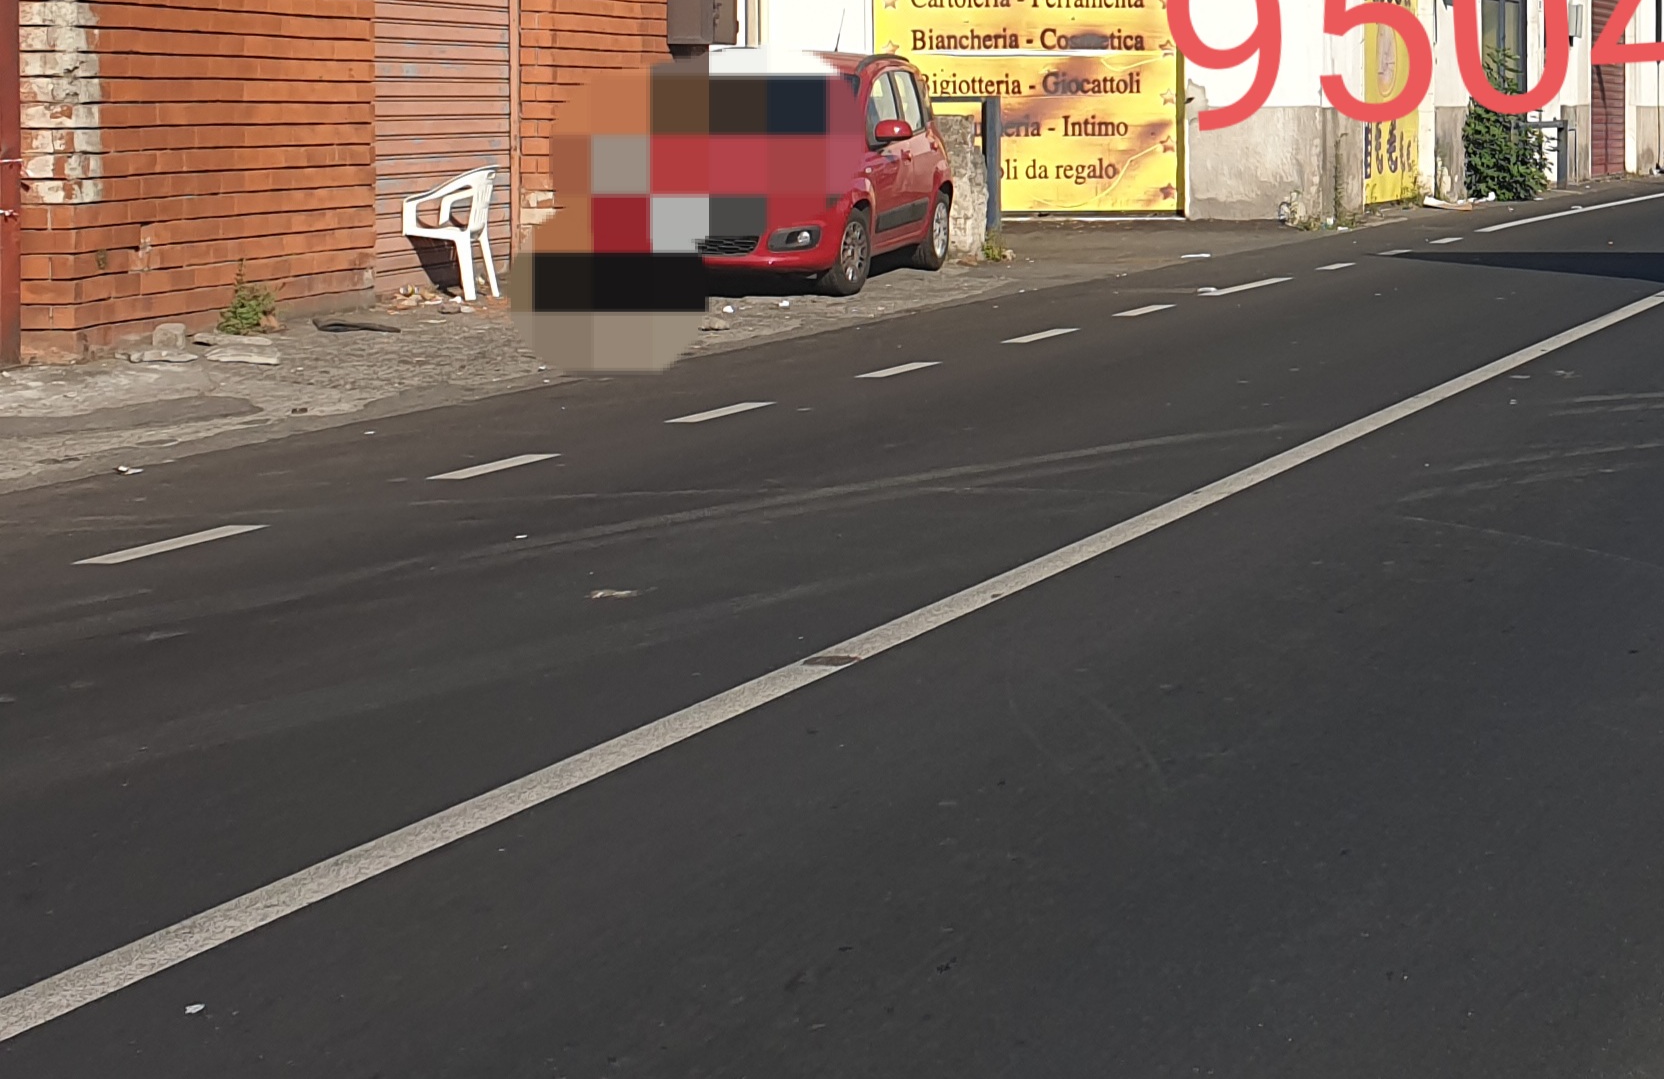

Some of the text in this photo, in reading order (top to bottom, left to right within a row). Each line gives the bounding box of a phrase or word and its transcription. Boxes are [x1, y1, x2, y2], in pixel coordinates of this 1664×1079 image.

[911, 28, 1019, 51] Biancheria
[1042, 72, 1141, 95] Giocattoli
[1062, 114, 1129, 137] Intimo
[1025, 158, 1050, 180] da
[1055, 159, 1118, 185] regalo
